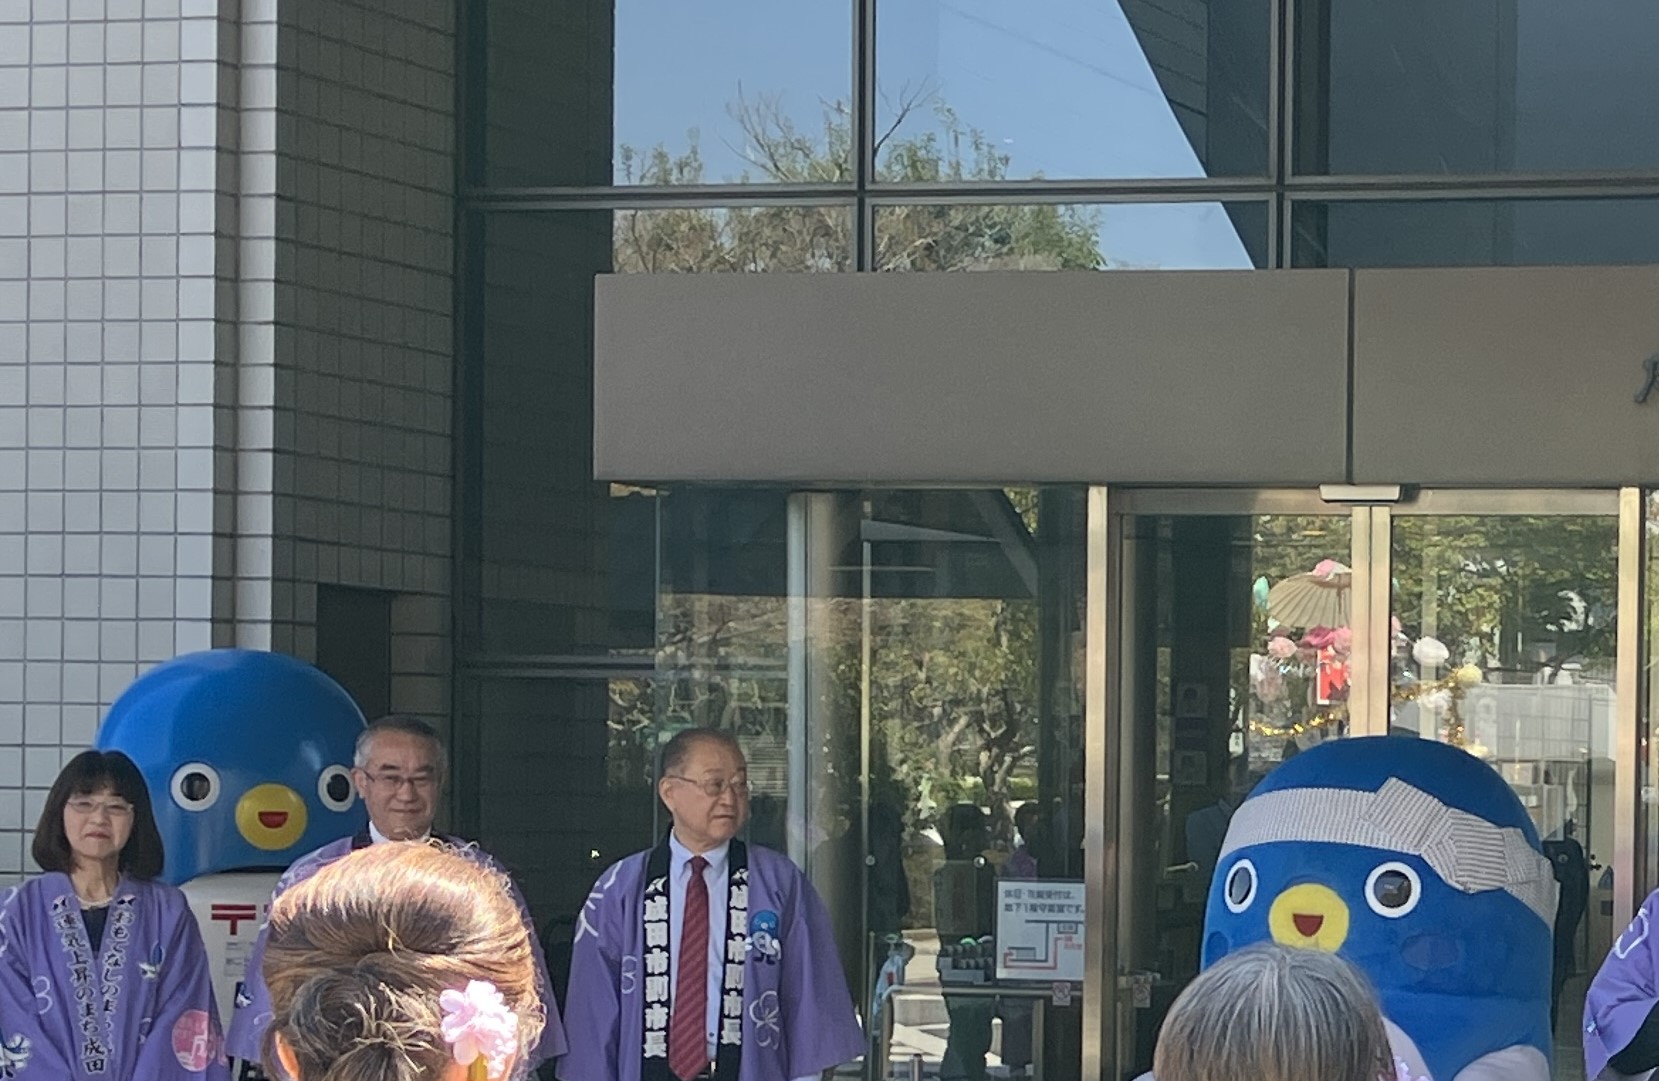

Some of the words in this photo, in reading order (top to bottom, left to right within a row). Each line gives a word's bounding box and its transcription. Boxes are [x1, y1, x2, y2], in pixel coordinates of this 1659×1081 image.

[55, 912, 107, 1075] 運気上昇のまち成田
[643, 895, 670, 1058] 成田市副市長
